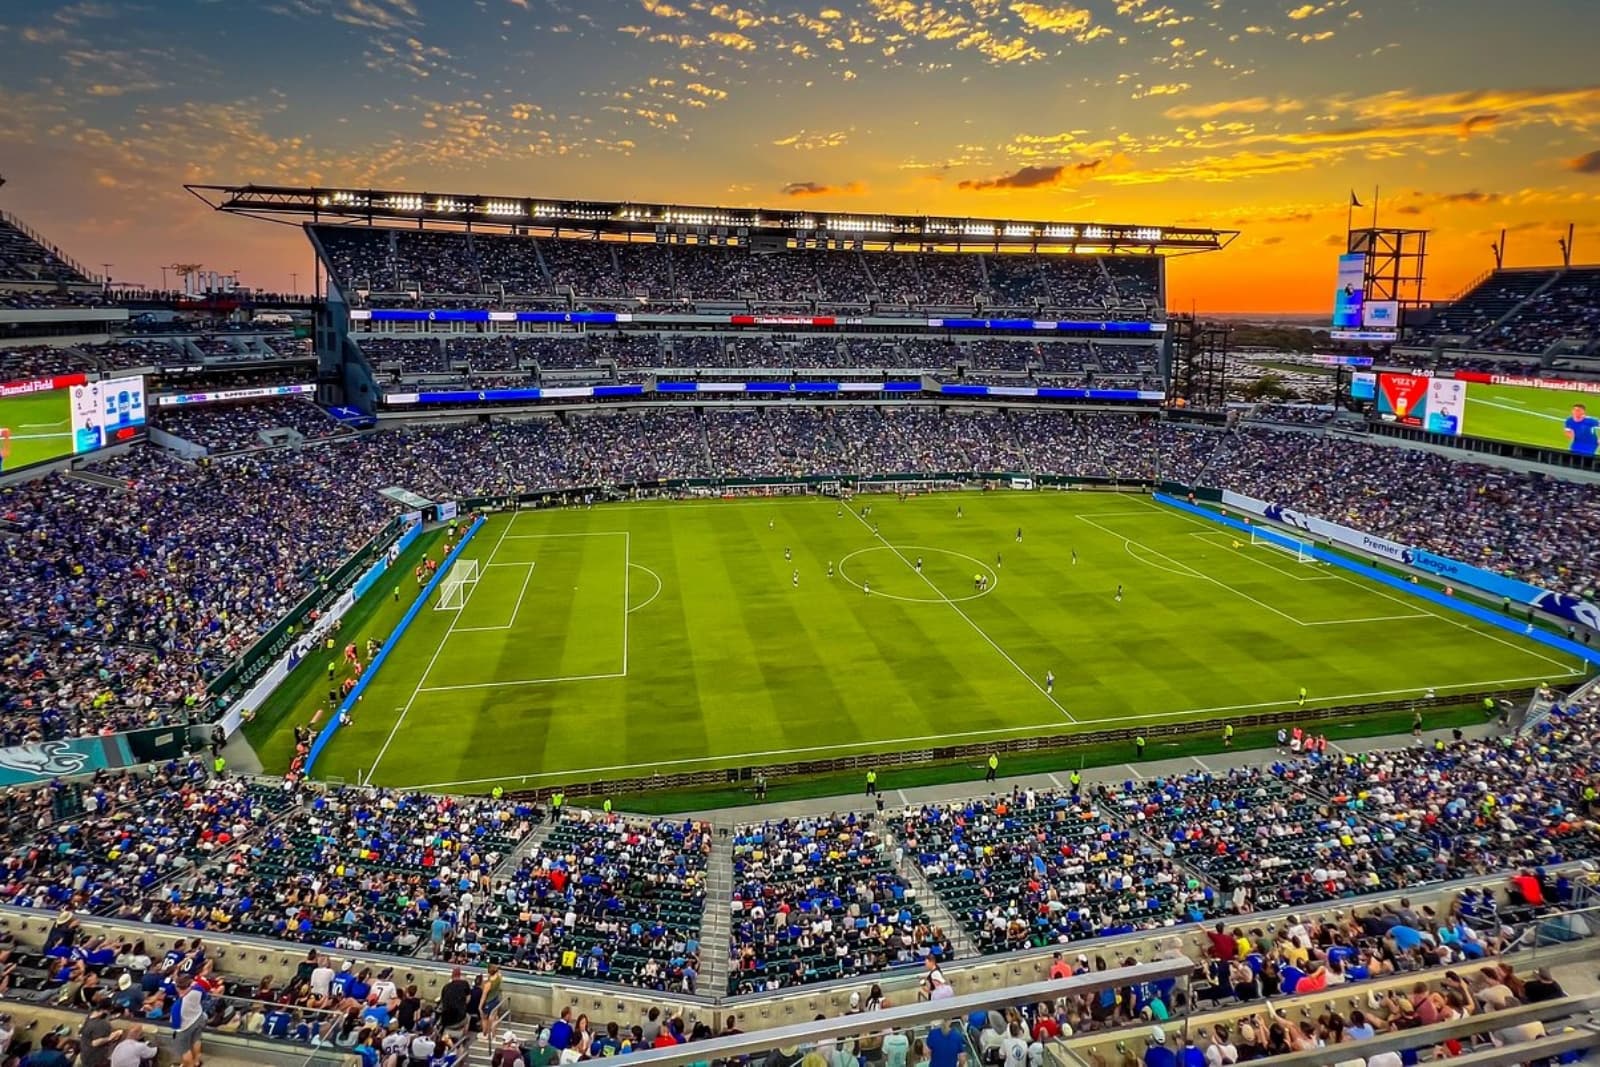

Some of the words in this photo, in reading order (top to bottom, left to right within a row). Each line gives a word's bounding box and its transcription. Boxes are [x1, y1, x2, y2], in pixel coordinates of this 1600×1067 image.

[34, 379, 54, 391] Field
[1392, 377, 1417, 387] VIZZY
[1502, 376, 1533, 386] Lincoln
[1534, 378, 1577, 391] Financial
[1363, 536, 1399, 555] Premier
[1416, 553, 1459, 574] League
[376, 986, 384, 1002] 7
[268, 1022, 276, 1035] 7
